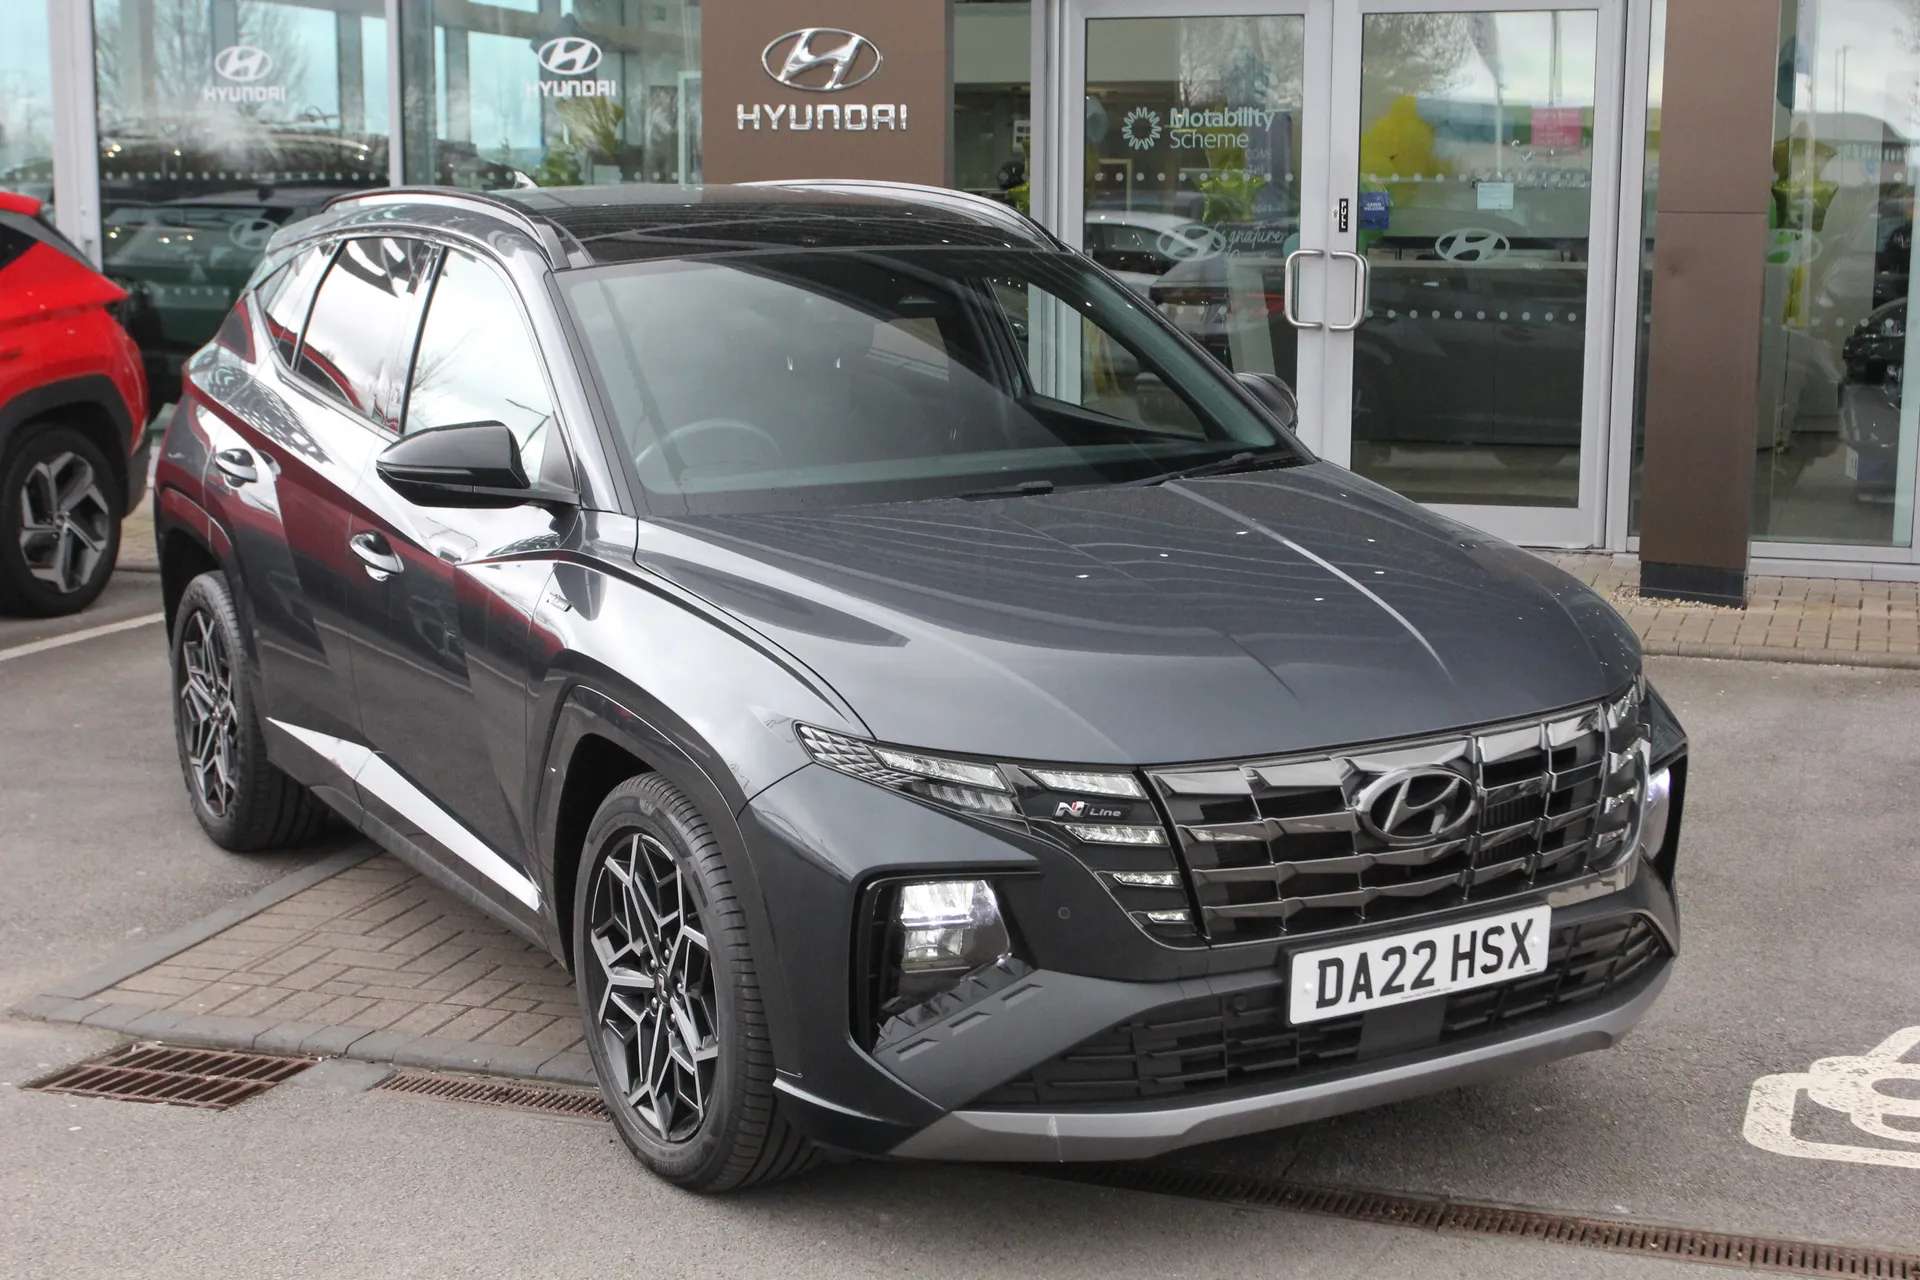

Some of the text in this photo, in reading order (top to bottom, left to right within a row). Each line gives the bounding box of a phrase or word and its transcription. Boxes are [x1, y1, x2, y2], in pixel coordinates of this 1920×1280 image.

[203, 86, 286, 103] HYUNDAI
[525, 79, 617, 97] HYUNDAI
[736, 103, 908, 130] HYUNDAI
[1170, 107, 1275, 132] Motability
[1170, 129, 1249, 149] Scheme
[1089, 808, 1122, 817] Line
[1315, 918, 1534, 1009] DA22 HSX
